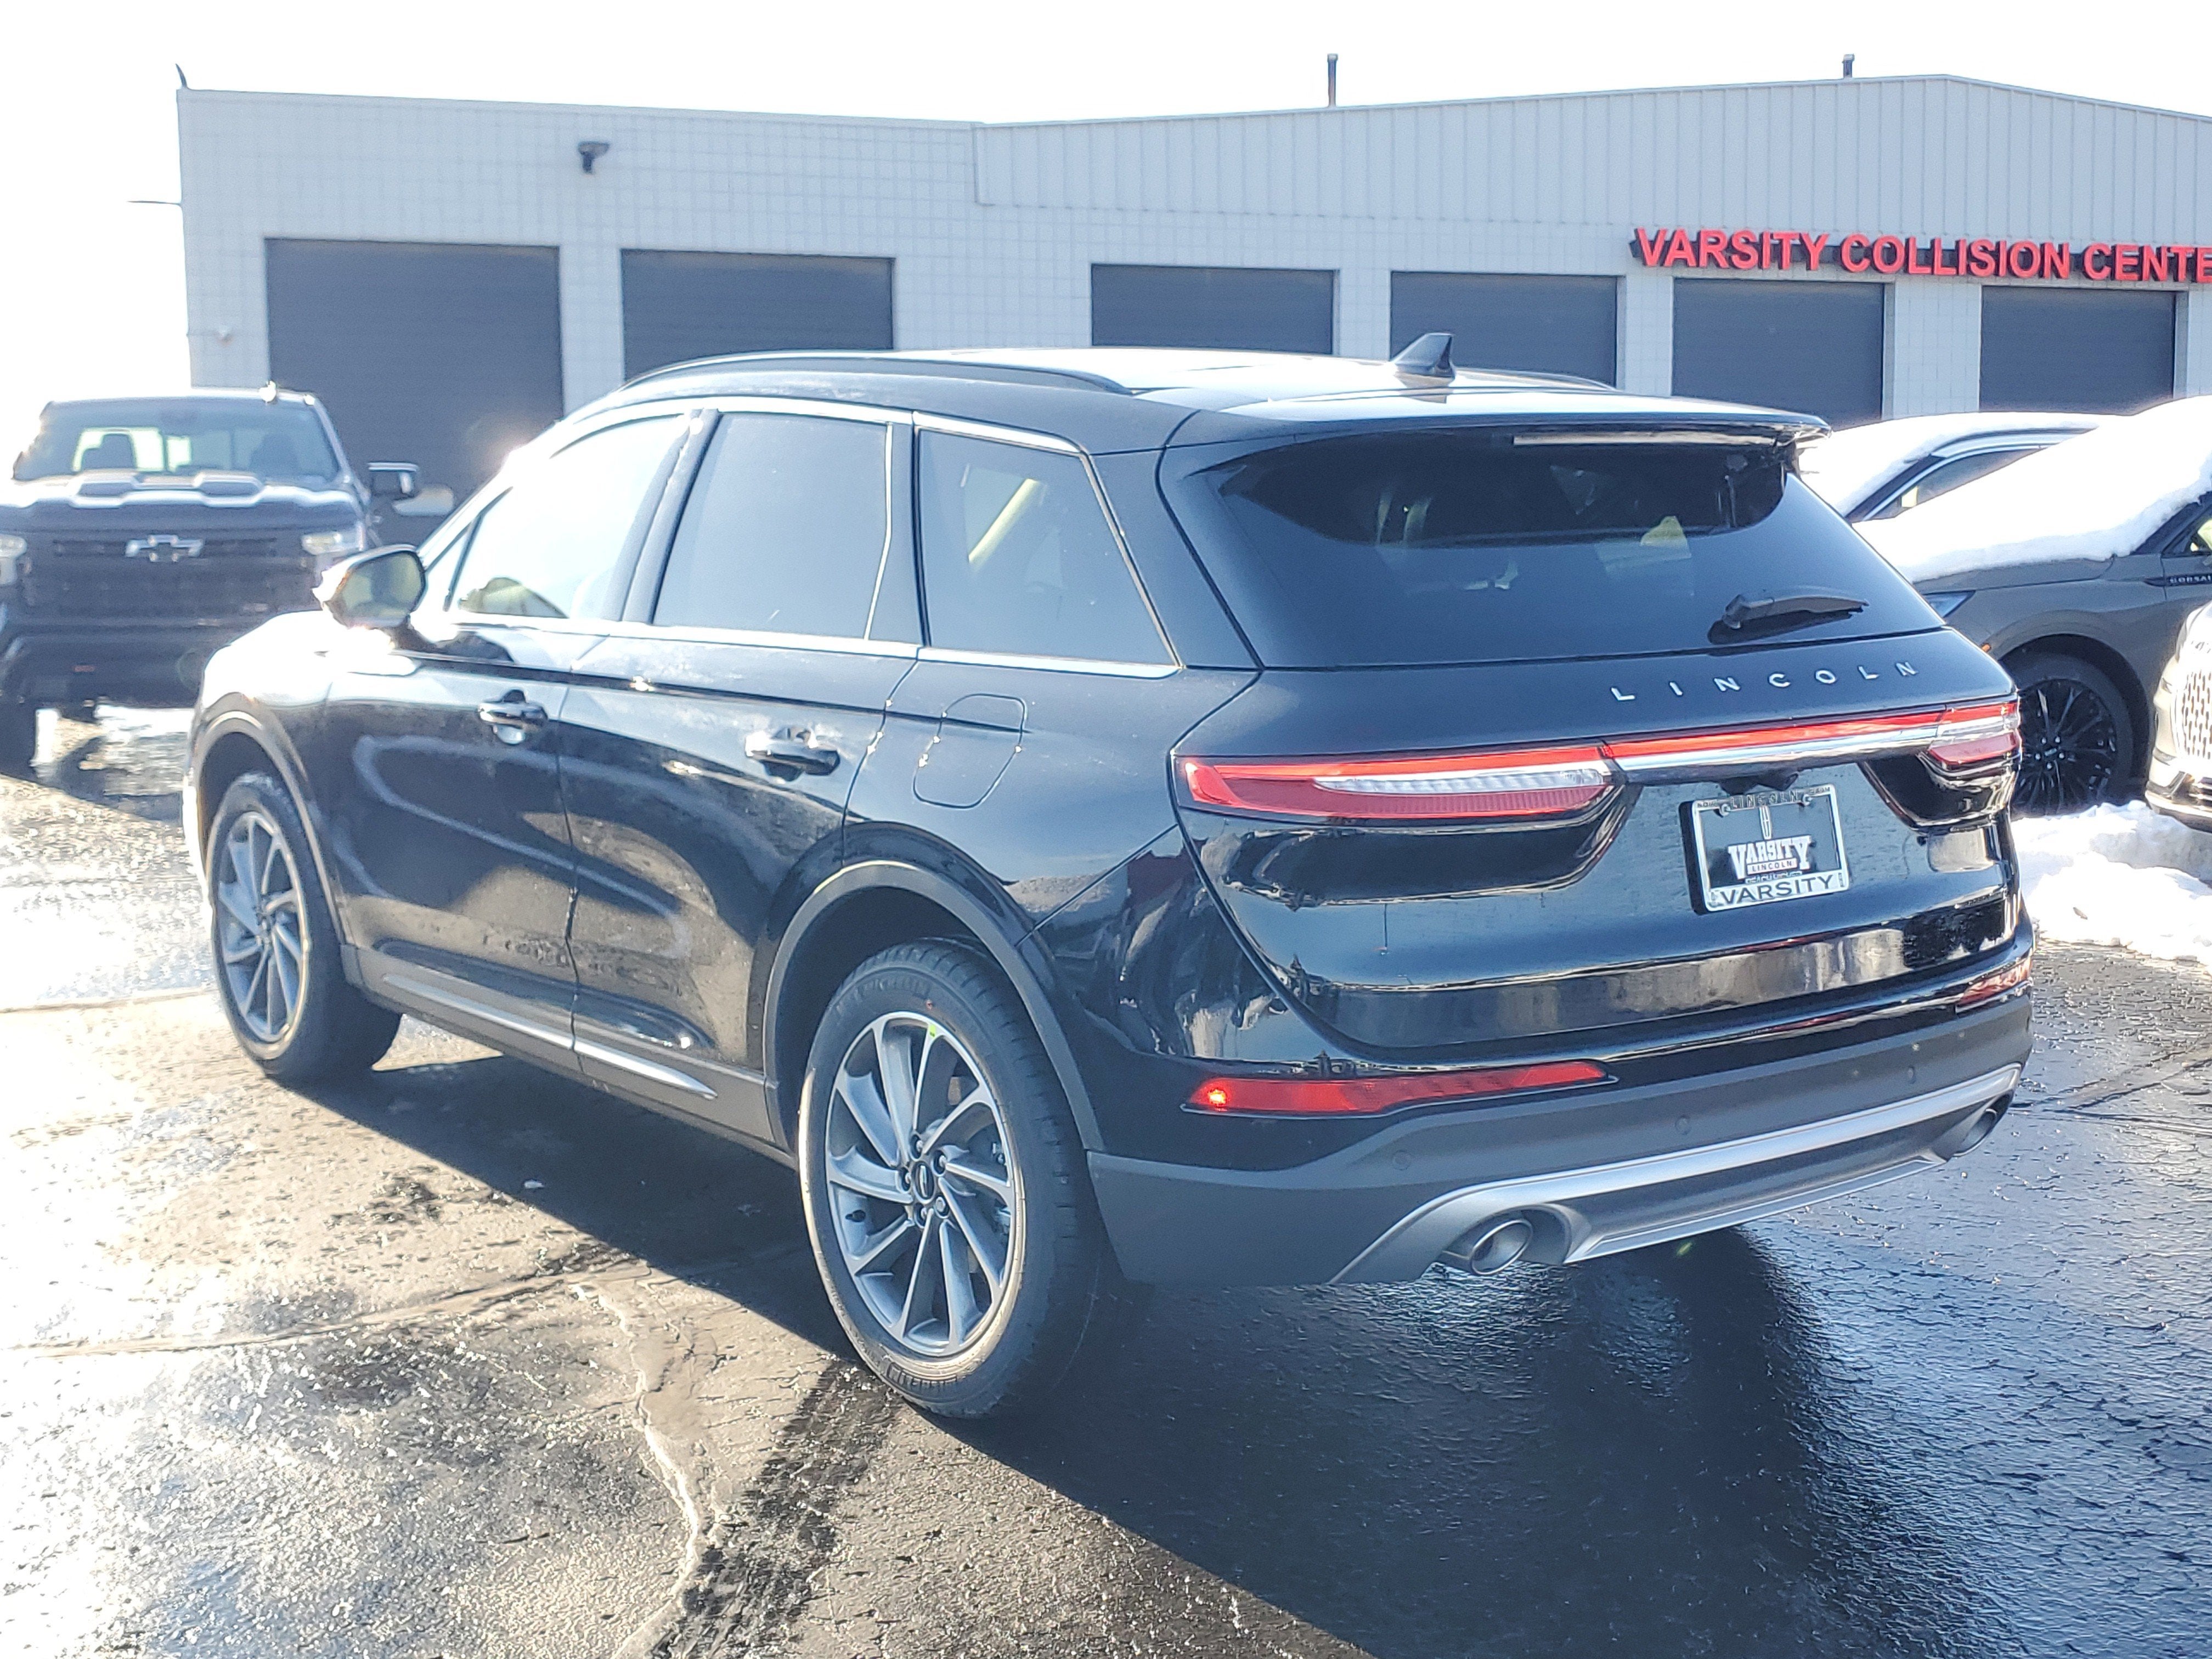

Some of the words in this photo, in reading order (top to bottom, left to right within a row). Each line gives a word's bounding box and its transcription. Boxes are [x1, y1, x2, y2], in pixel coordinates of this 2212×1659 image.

[1635, 227, 1830, 271] VARSITY
[1840, 233, 2070, 279] COLLISION
[2084, 243, 2212, 283] CENTE
[1611, 661, 1918, 702] LINCOLN
[1730, 788, 1798, 809] LINCOLN
[1728, 834, 1811, 881] VARSITY
[1751, 860, 1793, 873] LINCOLN
[1720, 874, 1834, 905] VARSITY
